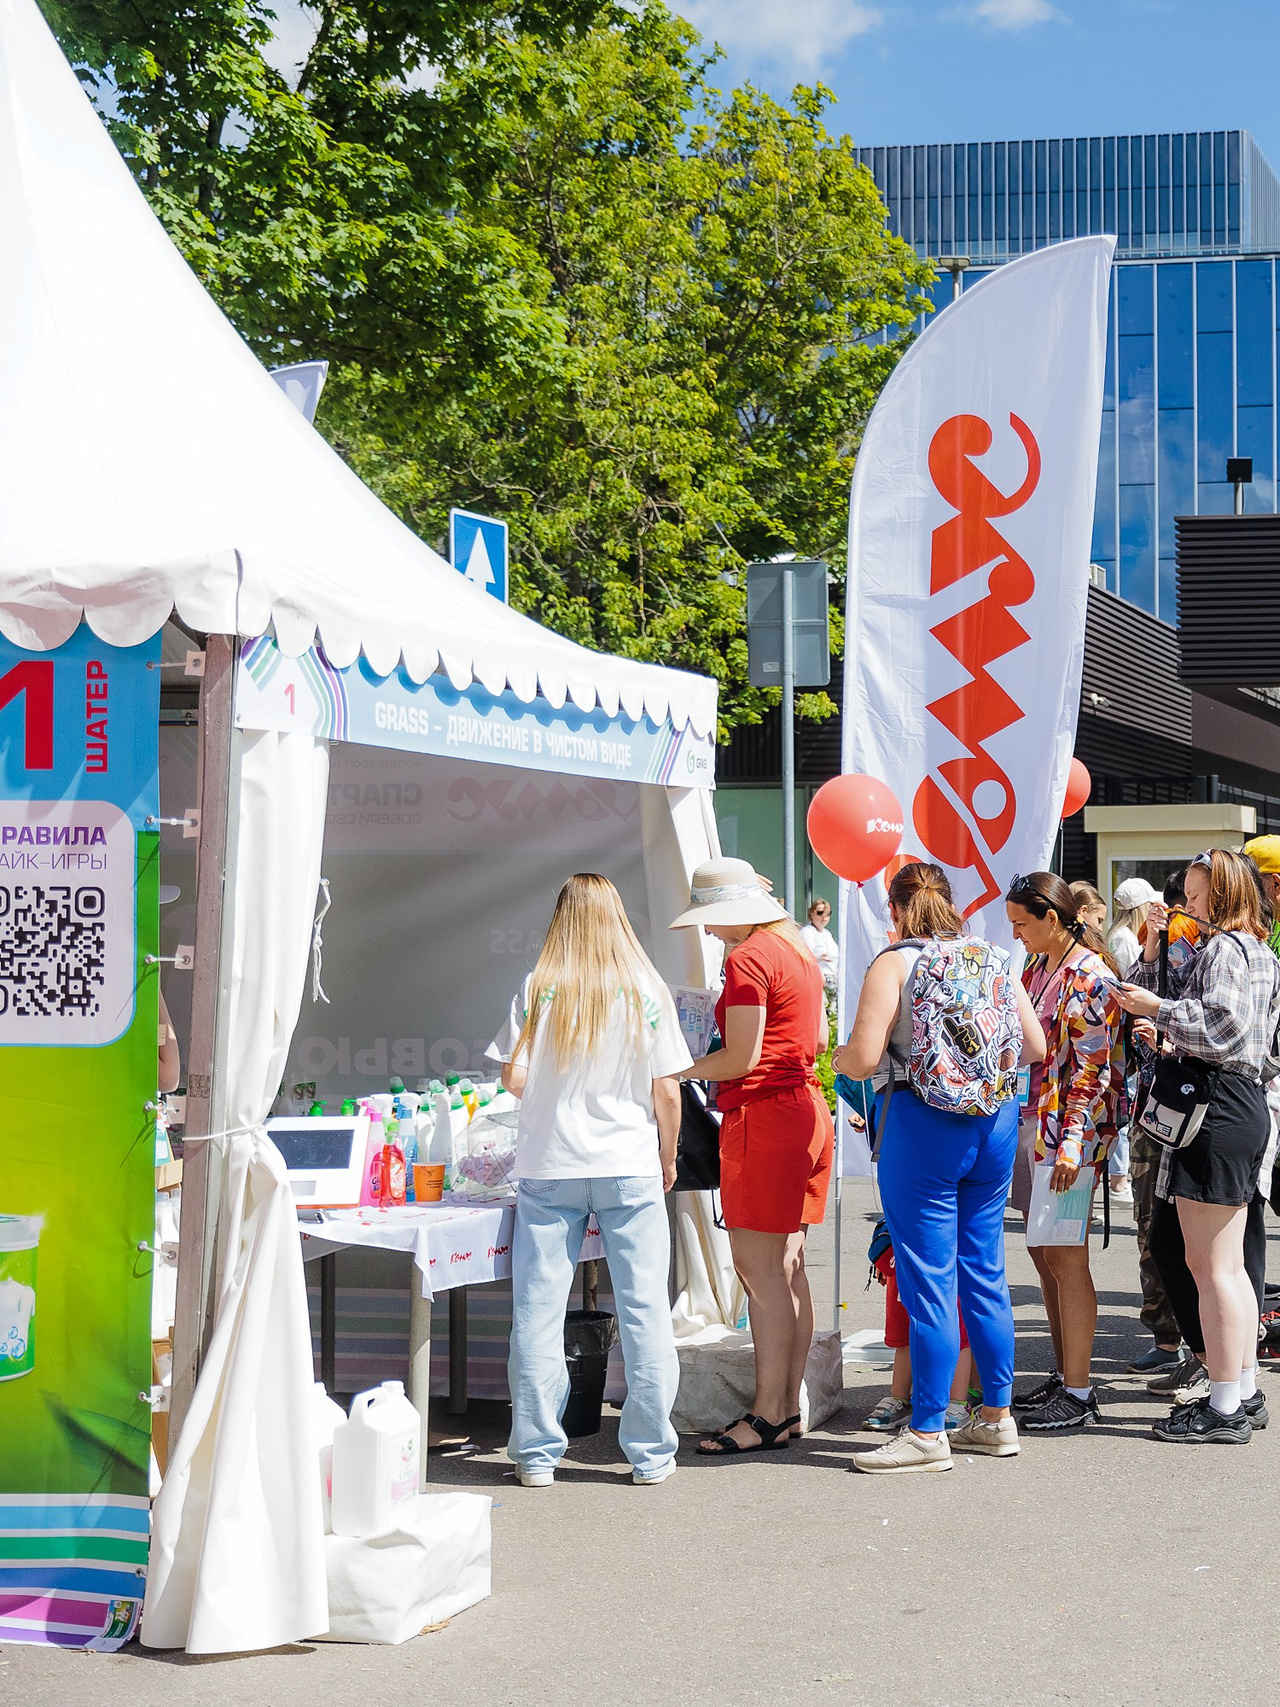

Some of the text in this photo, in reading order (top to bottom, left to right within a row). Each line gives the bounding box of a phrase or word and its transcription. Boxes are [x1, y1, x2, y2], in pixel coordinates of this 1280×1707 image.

[0, 661, 54, 770] 1
[86, 660, 108, 773] ШАТЕР
[284, 684, 295, 715] 1
[375, 701, 429, 736] GRASS
[446, 714, 529, 752] ДВИЖЕНИЕ
[533, 730, 542, 754] В
[546, 732, 598, 762] ЧИСТОМ
[601, 740, 632, 770] ВИДЕ
[2, 826, 108, 846] РАВИЛА
